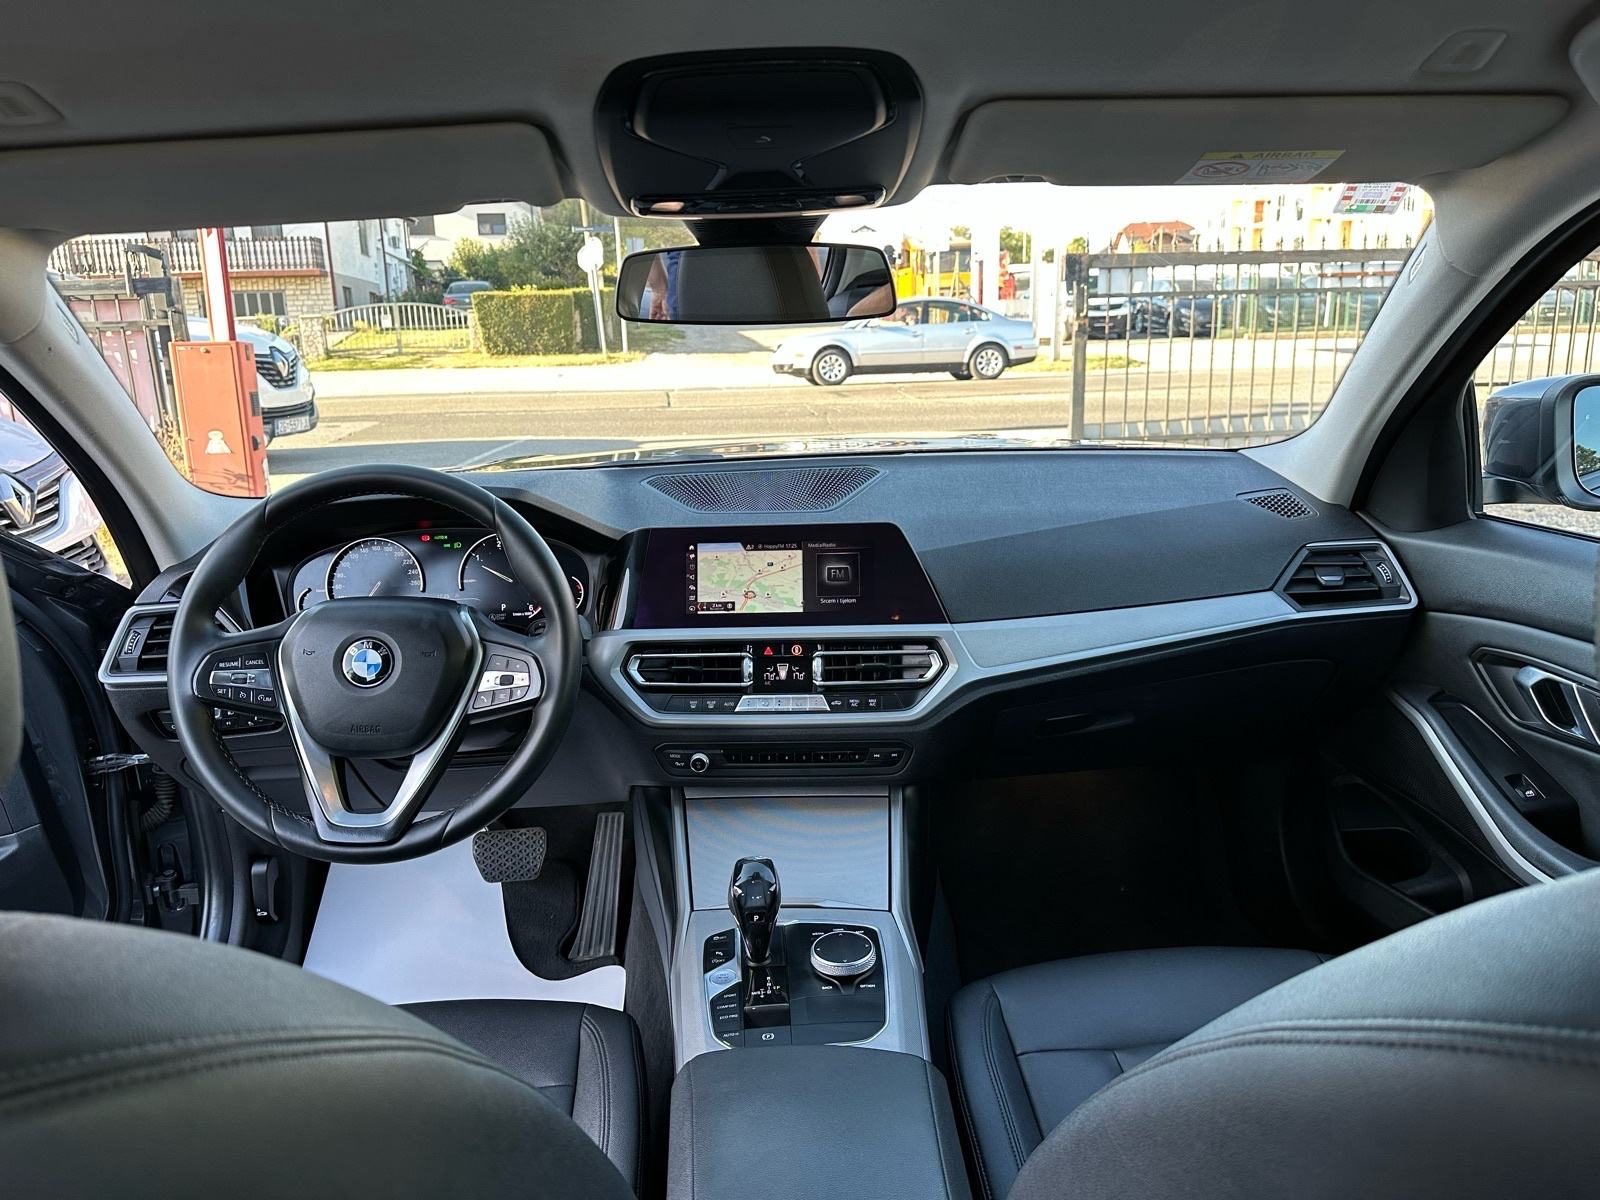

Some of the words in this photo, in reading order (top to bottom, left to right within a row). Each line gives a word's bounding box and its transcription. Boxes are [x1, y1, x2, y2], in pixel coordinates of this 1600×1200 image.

[1254, 151, 1316, 159] AIRBAG
[831, 569, 845, 578] FM
[350, 724, 381, 734] AIRBAG
